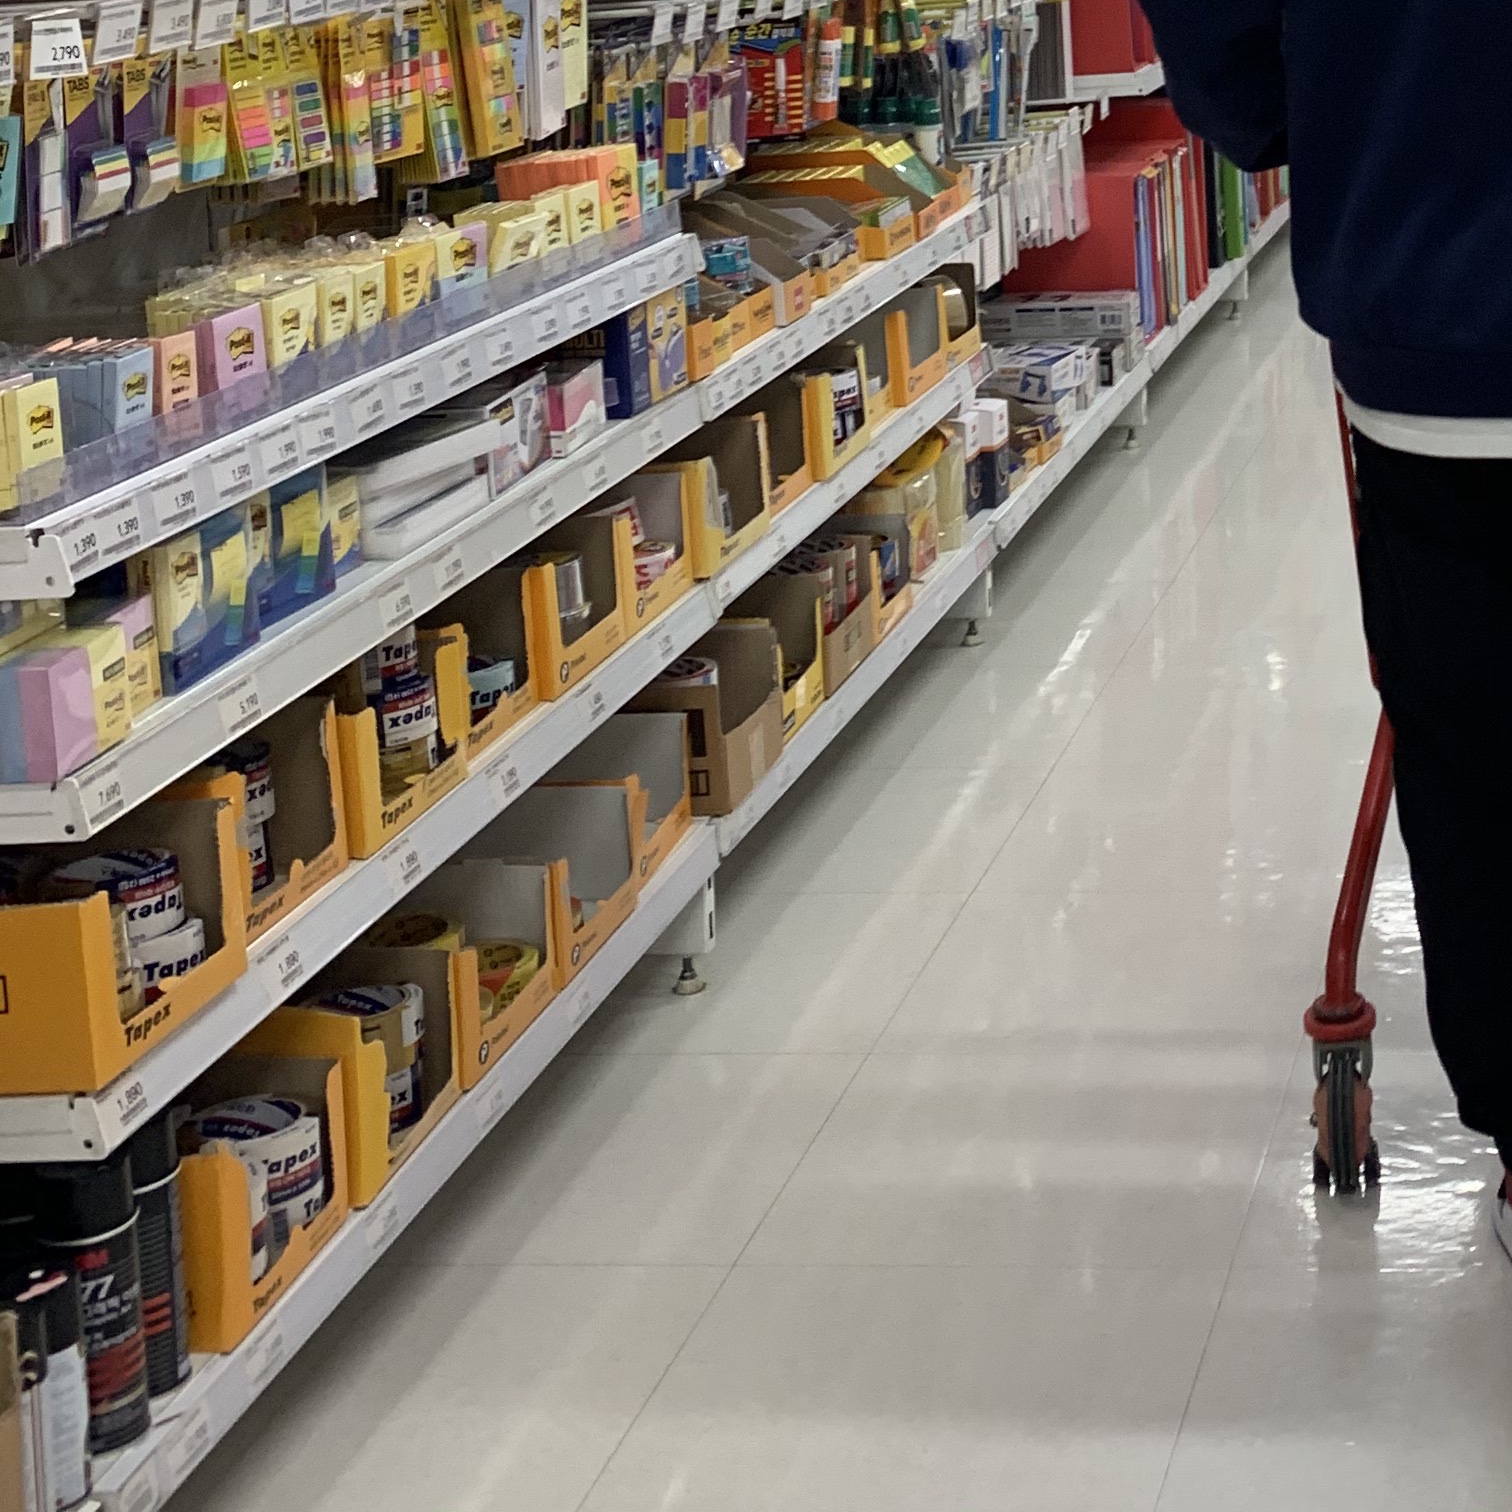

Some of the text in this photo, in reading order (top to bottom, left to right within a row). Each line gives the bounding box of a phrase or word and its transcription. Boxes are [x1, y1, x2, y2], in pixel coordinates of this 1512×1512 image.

[51, 44, 81, 62] 2,790
[66, 76, 89, 94] TABS
[126, 68, 147, 85] TABS
[381, 797, 414, 825] Tapex
[246, 895, 285, 933] Tapex
[124, 1001, 172, 1048] Tapex
[79, 1273, 116, 1305] 77
